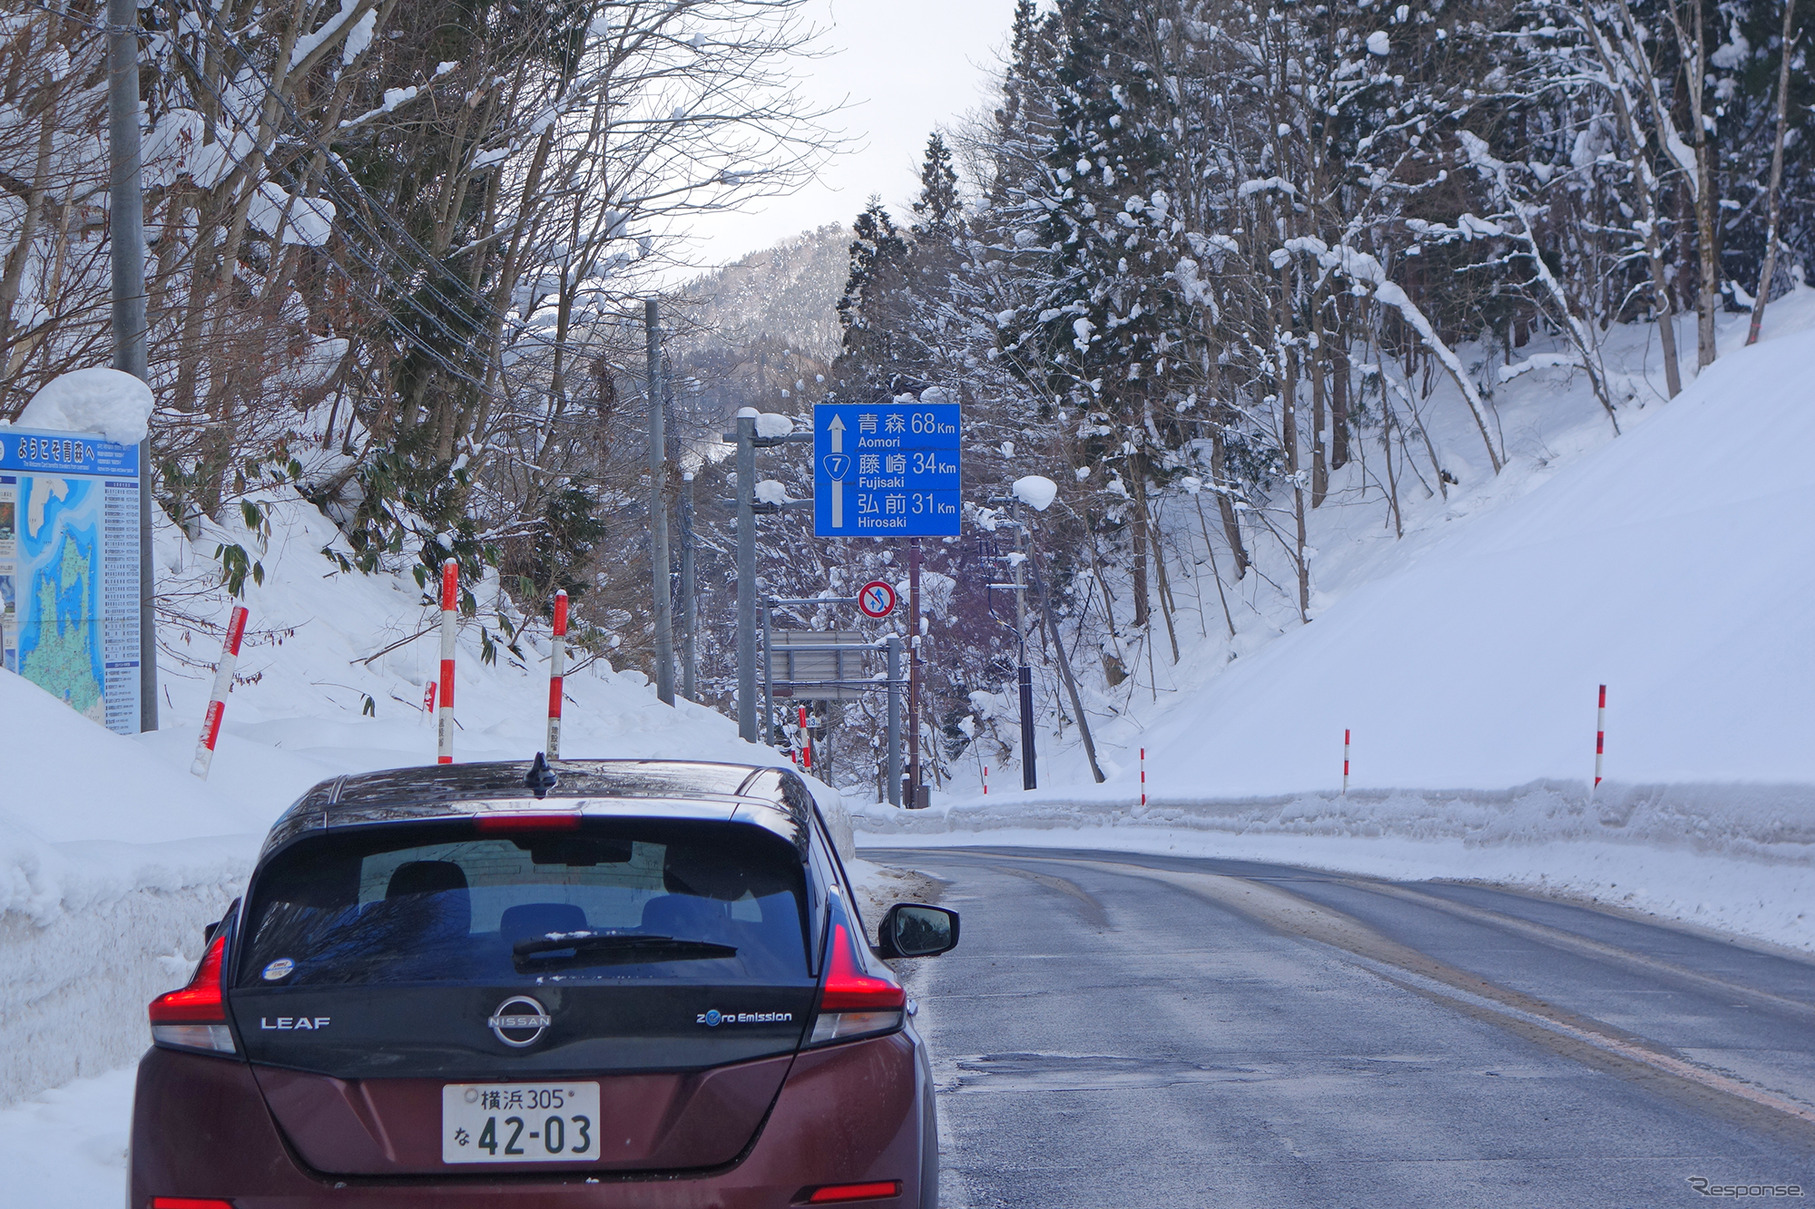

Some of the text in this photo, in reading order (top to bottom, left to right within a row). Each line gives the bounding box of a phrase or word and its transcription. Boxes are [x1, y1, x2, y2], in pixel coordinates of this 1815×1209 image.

[858, 413, 906, 434] 青森
[858, 437, 900, 447] Aomori
[18, 437, 95, 463] ようこそ青森へ
[832, 458, 842, 472] 7
[859, 453, 907, 474] 藤崎
[859, 477, 904, 490] Fujisaki
[858, 493, 906, 514] 弘前
[858, 517, 907, 528] Hirosaki
[261, 1017, 331, 1029] LEAF
[489, 1017, 550, 1027] NISSAN
[454, 1114, 591, 1155] な 42-03
